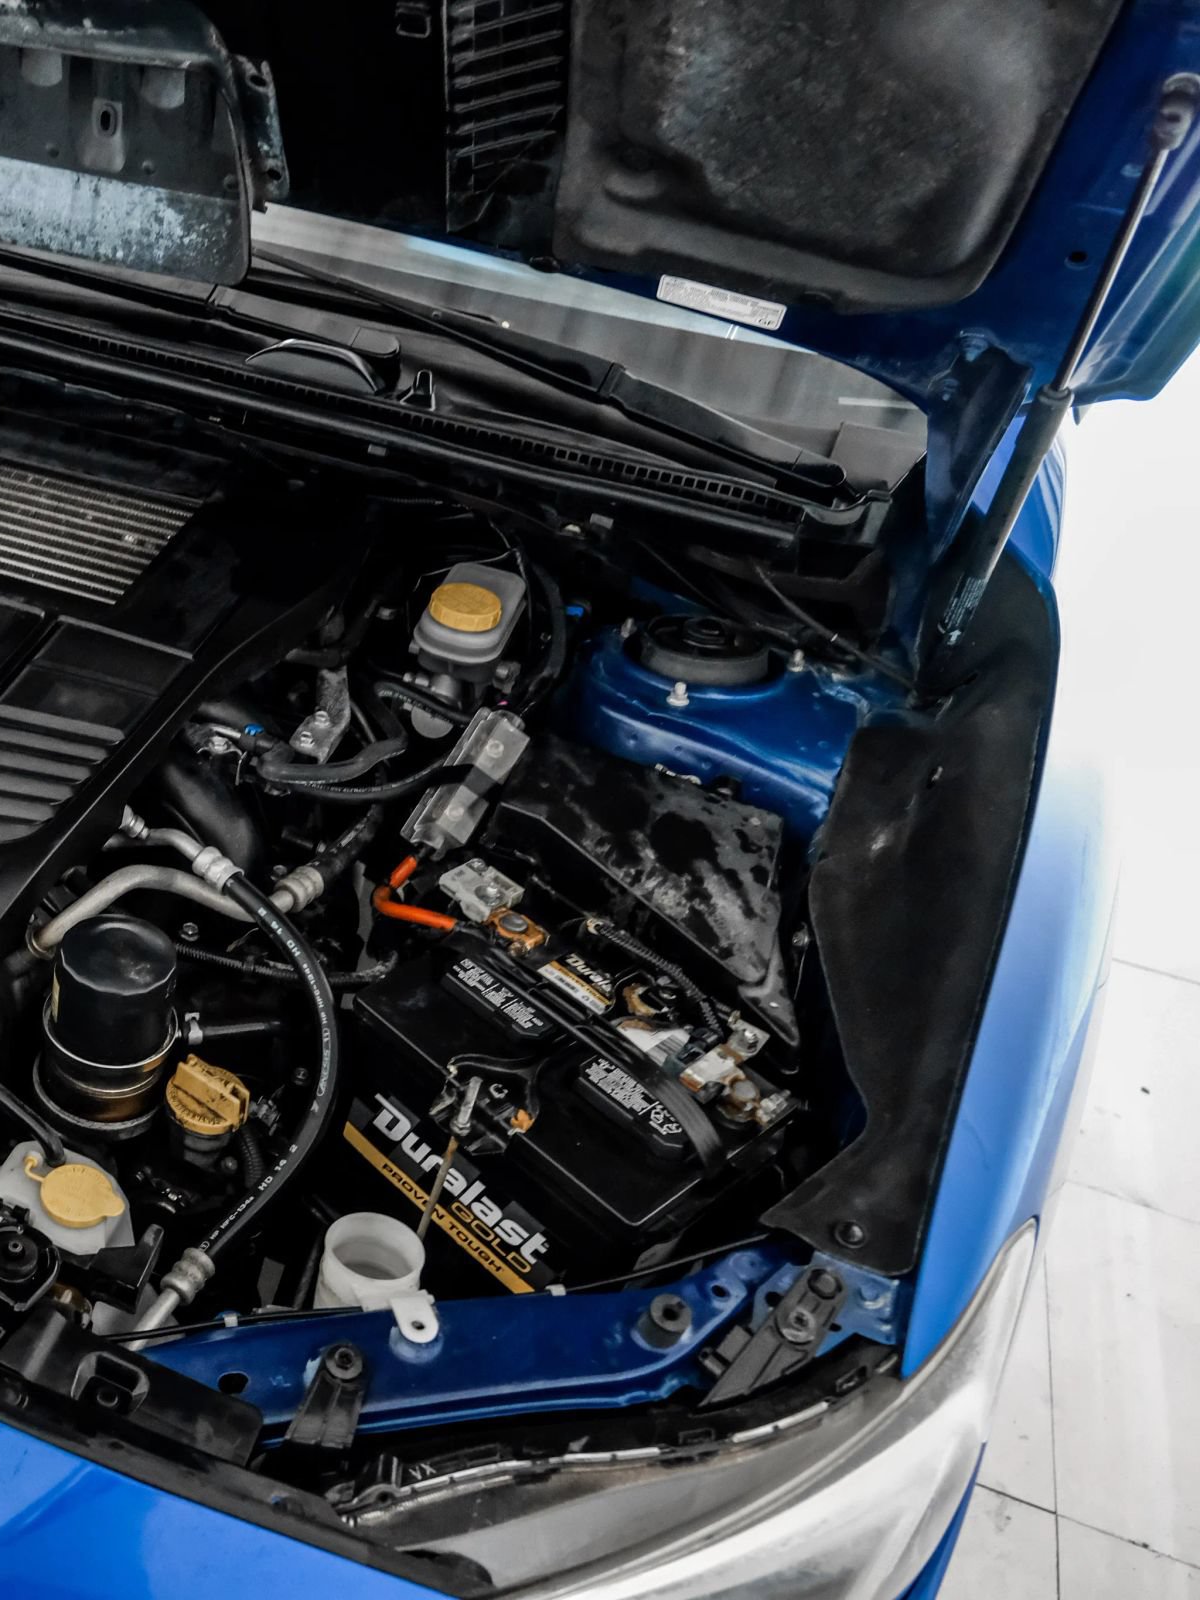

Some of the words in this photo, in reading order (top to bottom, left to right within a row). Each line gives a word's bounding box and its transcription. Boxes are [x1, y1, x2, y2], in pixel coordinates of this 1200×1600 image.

[286, 939, 301, 957] HD
[257, 1175, 274, 1191] HD
[289, 1143, 299, 1153] 2
[373, 1092, 550, 1266] Duralast
[448, 1222, 502, 1273] TOUGH
[451, 1202, 532, 1273] GOLD
